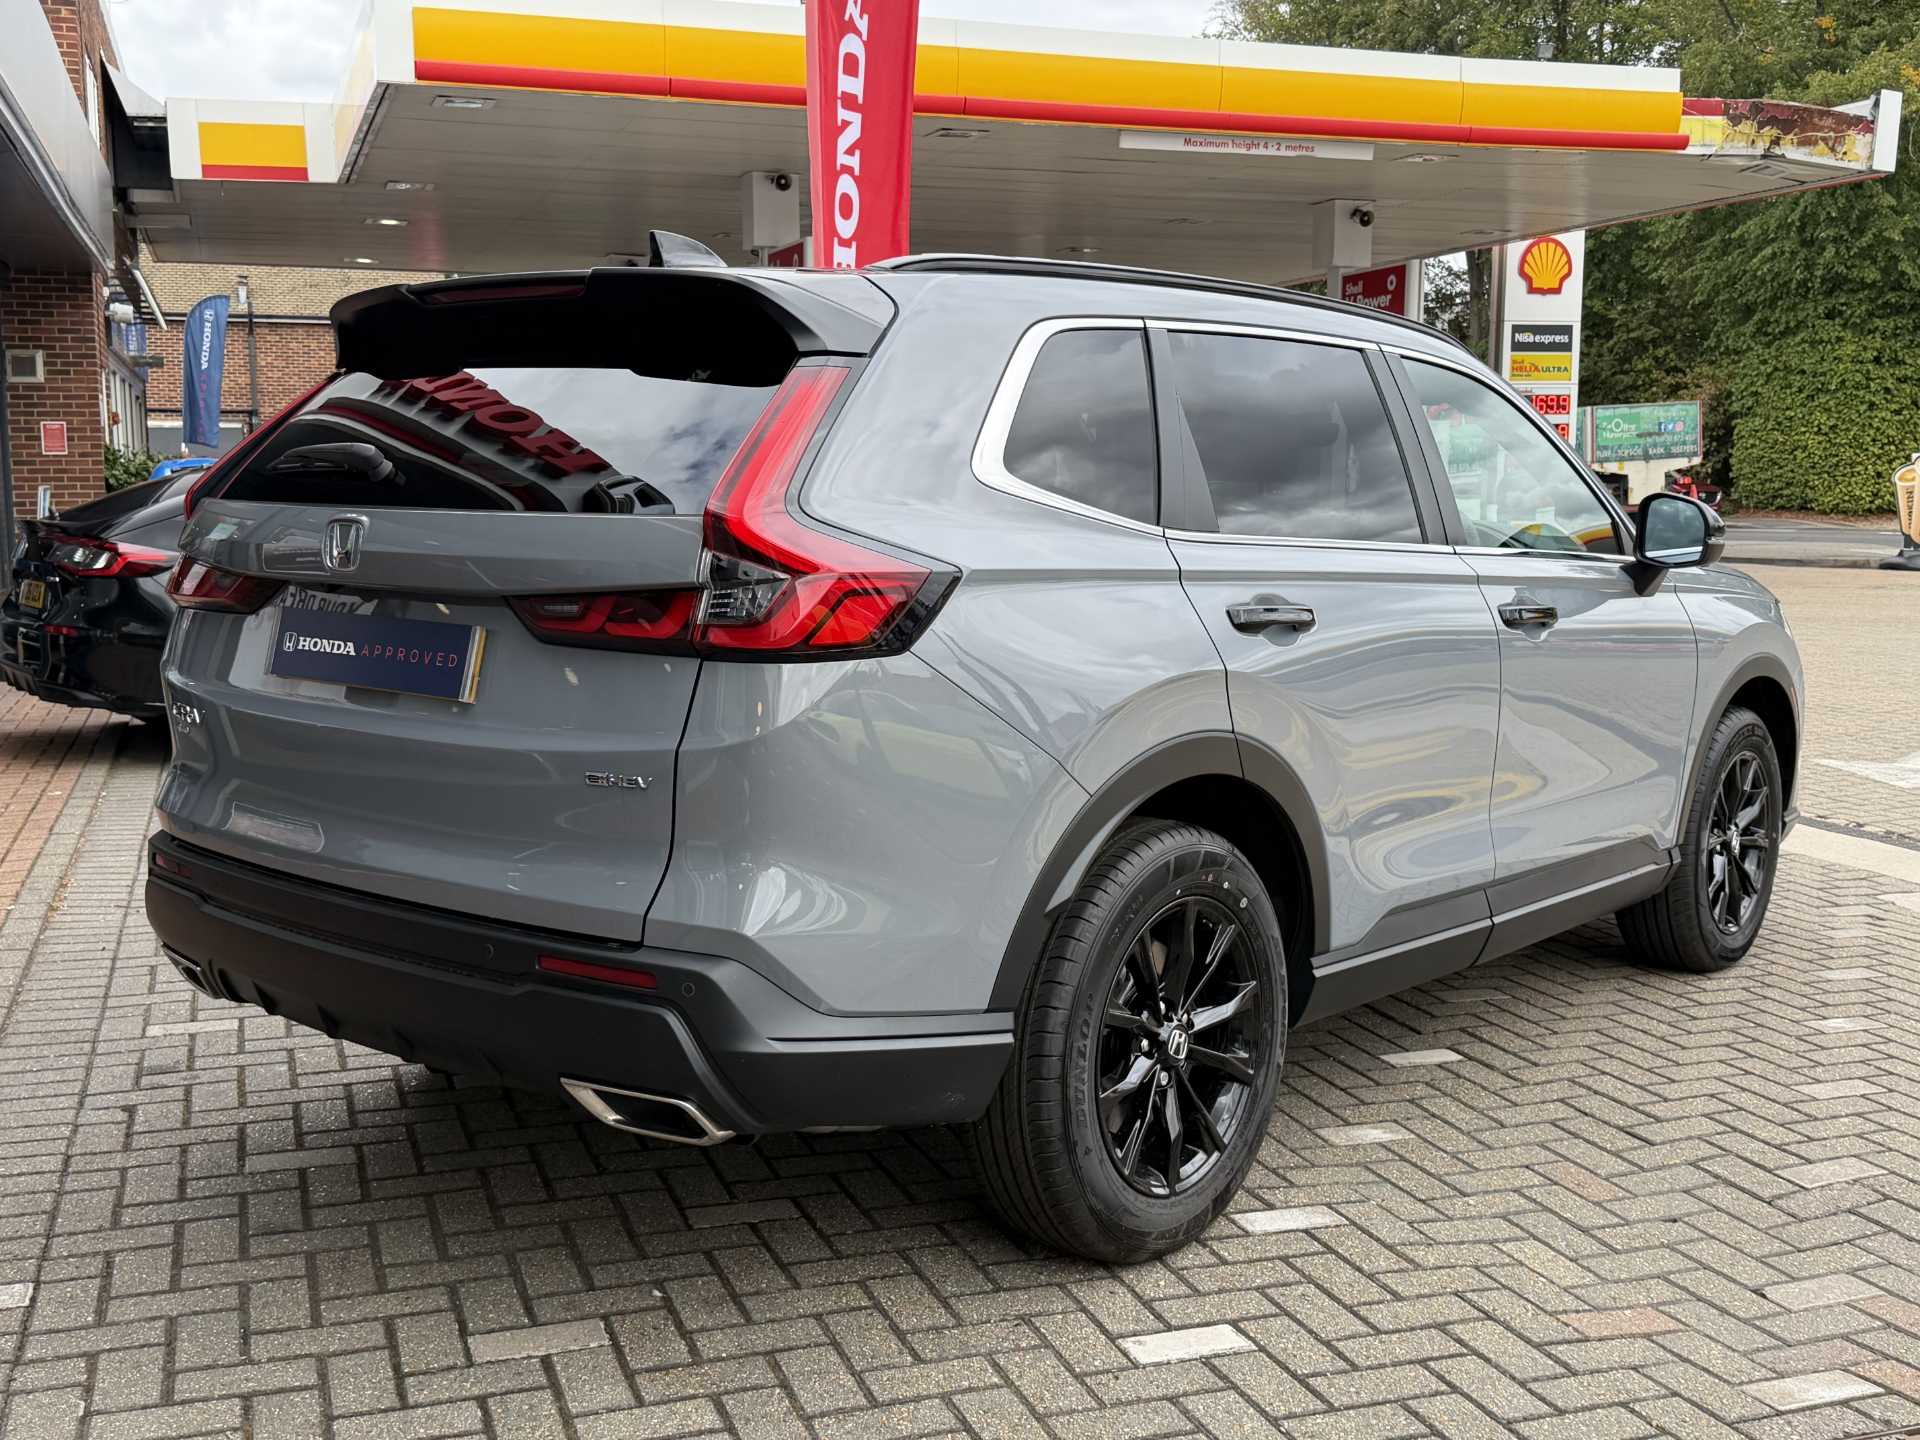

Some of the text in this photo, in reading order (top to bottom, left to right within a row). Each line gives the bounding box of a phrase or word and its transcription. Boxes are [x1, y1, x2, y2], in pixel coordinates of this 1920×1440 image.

[834, 0, 869, 270] HONDA
[1183, 138, 1229, 148] Maximum
[1231, 139, 1260, 151] height
[1284, 143, 1315, 153] metres
[1345, 280, 1363, 296] Shell
[202, 321, 213, 371] HONDA
[1535, 334, 1569, 344] express
[297, 637, 458, 667] HONDA APPROVED
